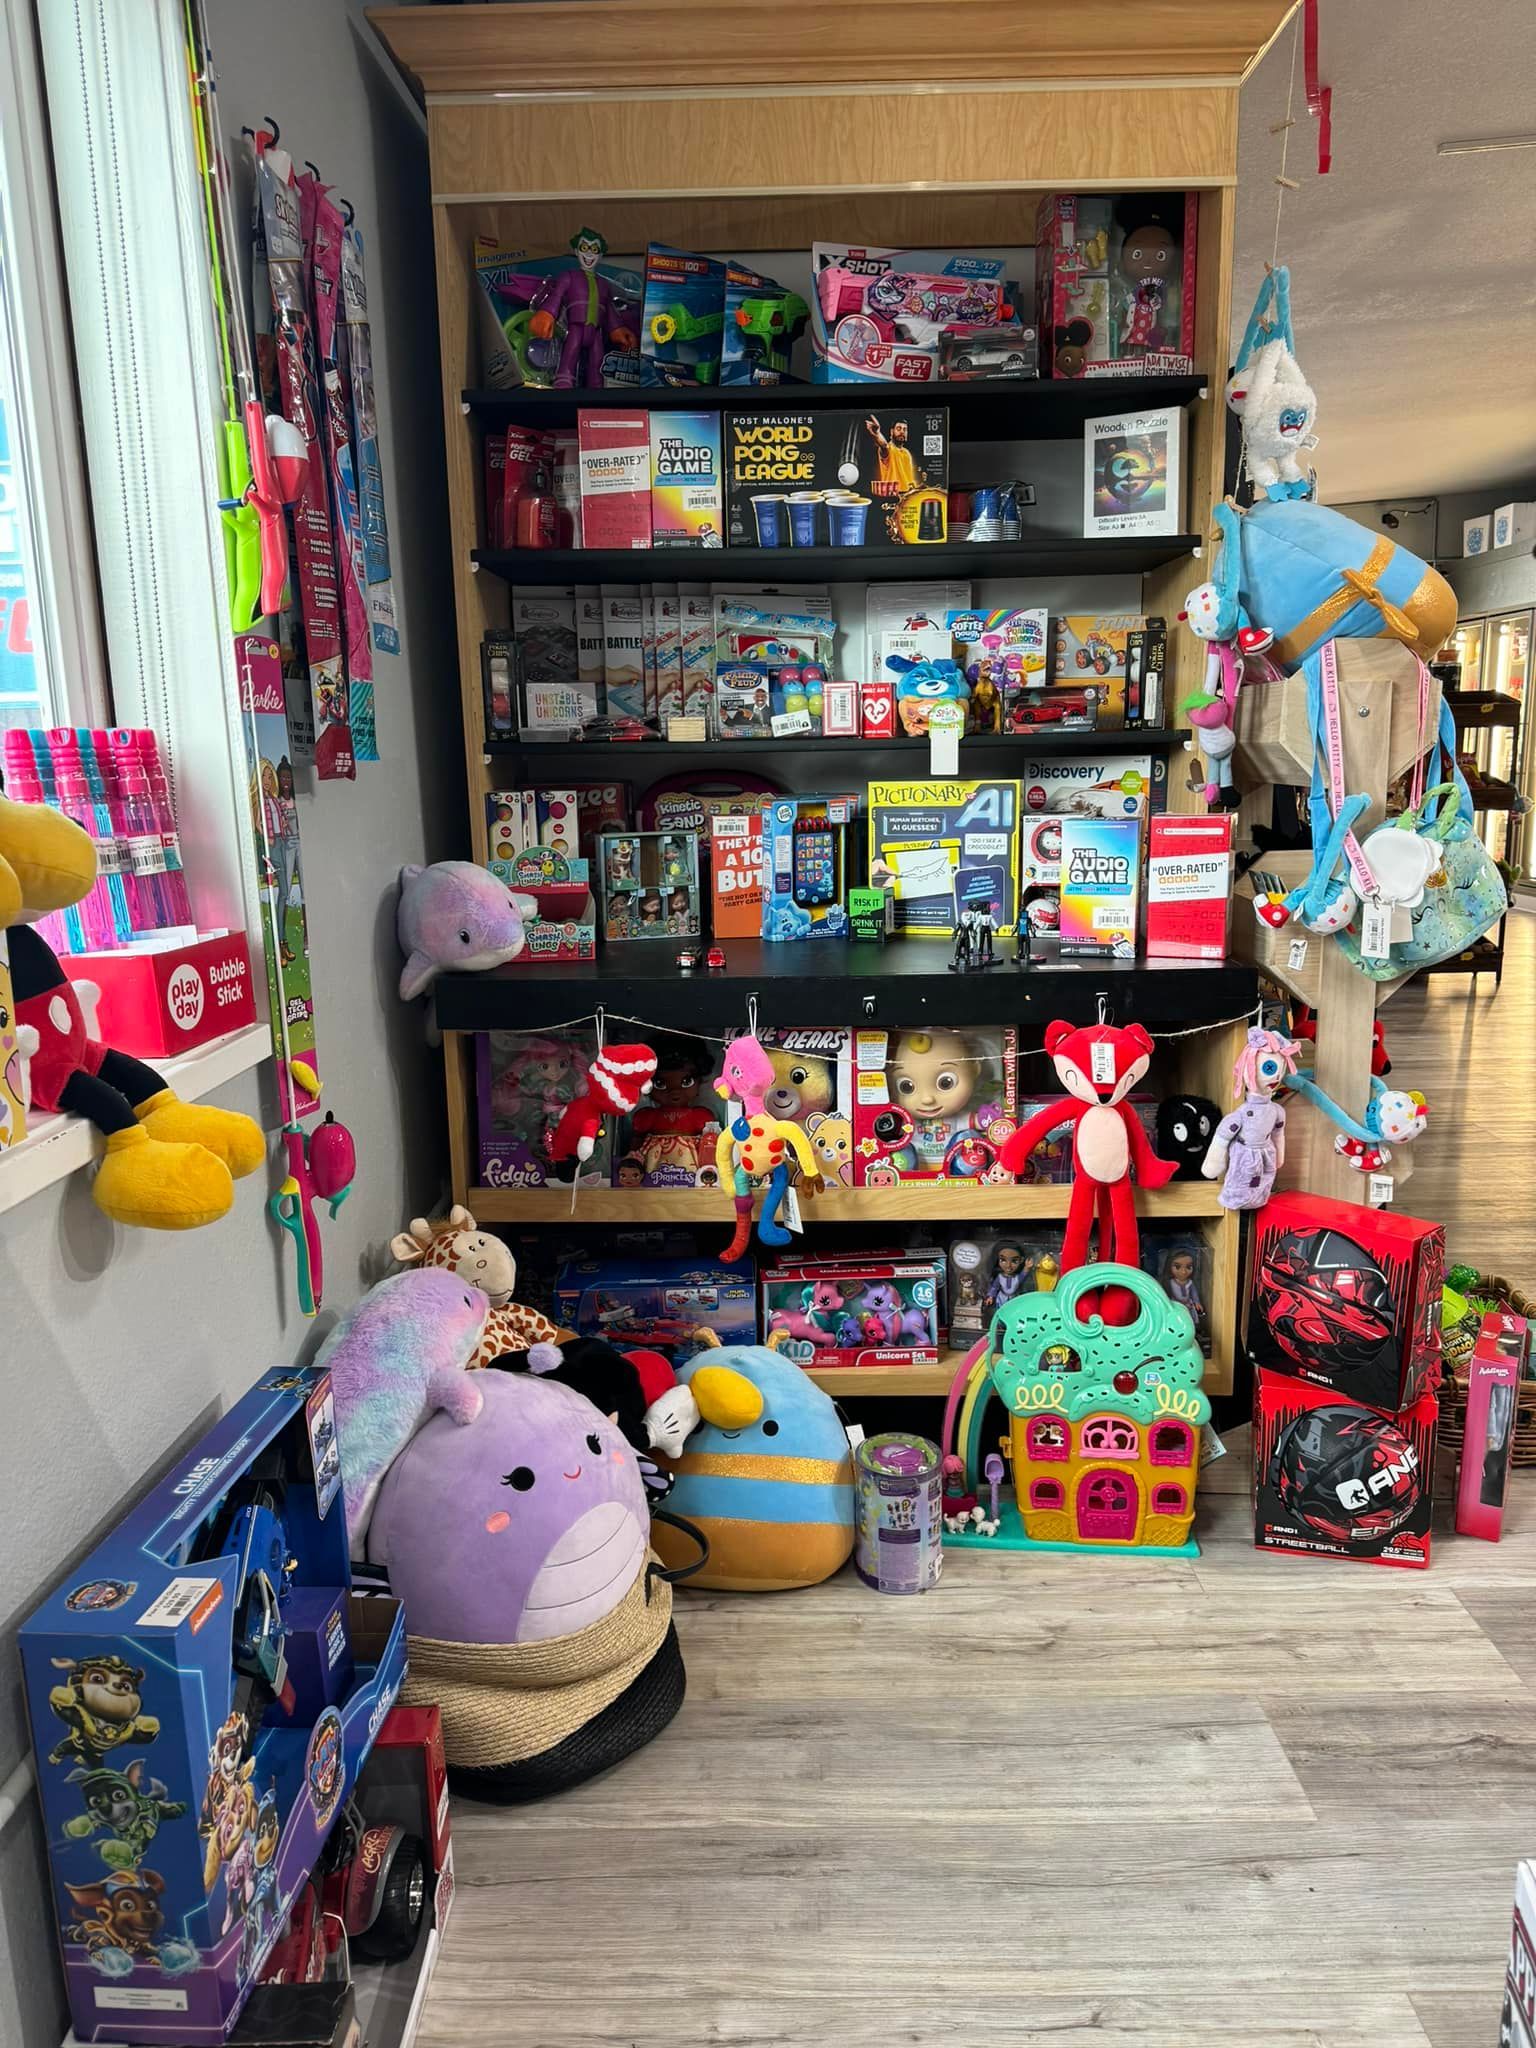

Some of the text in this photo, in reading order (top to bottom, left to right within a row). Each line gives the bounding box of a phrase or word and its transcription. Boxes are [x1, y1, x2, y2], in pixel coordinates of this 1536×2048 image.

[895, 362, 931, 375] FAST
[1144, 357, 1162, 371] ADA
[900, 373, 926, 384] FILL
[733, 416, 814, 425] POST MALONE'S
[1094, 416, 1169, 434] Wooden Puzzle
[734, 425, 814, 443] WORLD
[661, 439, 683, 449] THE
[509, 450, 533, 463] GEL
[659, 448, 712, 461] AUDIO
[734, 444, 800, 462] PONG
[659, 461, 712, 474] GAME
[734, 463, 816, 481] LEAGUE
[951, 620, 985, 632] SOFTEE
[1324, 647, 1336, 696] HELLO KITTY
[242, 680, 284, 712] Barbie
[535, 706, 584, 719] UNICORNS
[1328, 718, 1341, 769] HELLO KITTY
[1029, 763, 1105, 782] Discovery
[659, 799, 702, 815] Kinetic
[871, 785, 1013, 828] PICTIONARY AI
[717, 835, 763, 851] THEY'R
[725, 853, 738, 867] A
[740, 847, 763, 866] 10
[1073, 849, 1096, 858] THE
[1070, 857, 1128, 871] AUDIO
[1152, 862, 1223, 876] "OVER-RATED"
[1353, 854, 1368, 877] HELLO
[1070, 870, 1127, 883] GAME
[853, 898, 881, 907] RISK IT
[851, 919, 884, 928] DRINK IT
[528, 931, 562, 942] SMASH
[209, 957, 246, 985] Bubble
[172, 979, 200, 1006] play
[216, 980, 244, 1007] Stick
[175, 996, 201, 1024] day
[288, 1005, 306, 1014] TECH
[289, 999, 304, 1008] GEL
[782, 1030, 846, 1049] BEARS
[1004, 1028, 1017, 1113] Learn with JJ
[481, 1158, 543, 1187] fidgie
[650, 1171, 696, 1184] PRINCESS
[663, 1165, 685, 1174] Disney
[917, 1287, 933, 1298] 16
[776, 1341, 815, 1357] KID
[876, 1351, 926, 1361] Unicorn Set
[1449, 1340, 1472, 1357] DINO
[172, 1456, 220, 1496] CHASE
[172, 1492, 195, 1522] MIGHTY
[1263, 1537, 1351, 1555] STREETBALL
[368, 1687, 392, 1734] CHASE
